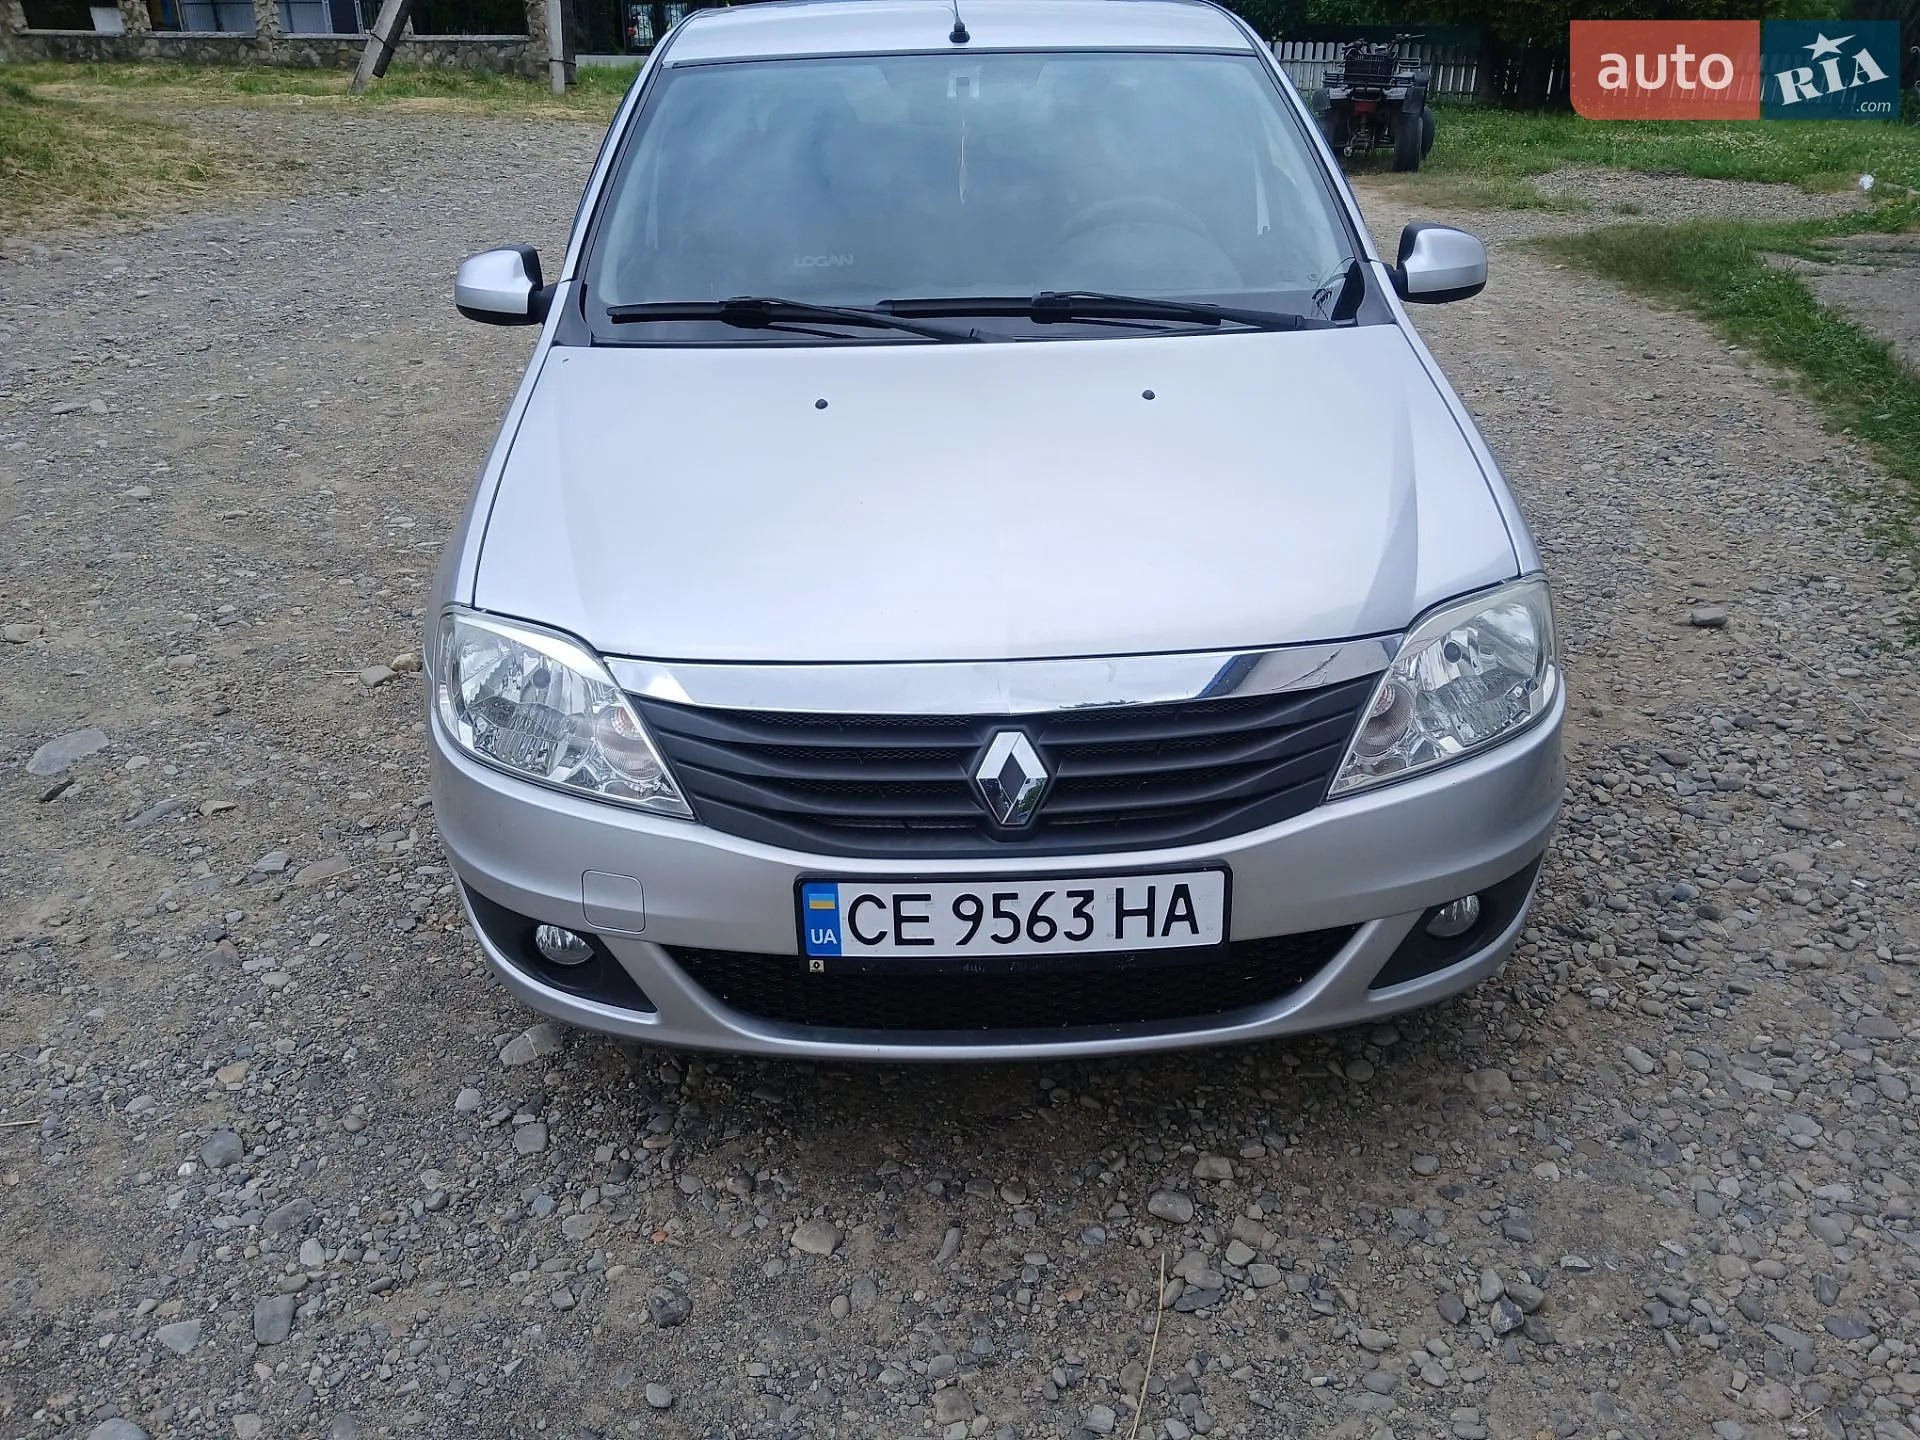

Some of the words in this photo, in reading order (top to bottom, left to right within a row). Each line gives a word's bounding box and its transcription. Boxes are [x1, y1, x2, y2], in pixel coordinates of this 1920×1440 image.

[794, 254, 853, 267] LOGAN
[848, 894, 934, 946] CE
[952, 889, 1095, 946] 9563
[1115, 884, 1200, 940] HA
[811, 928, 837, 945] UA
